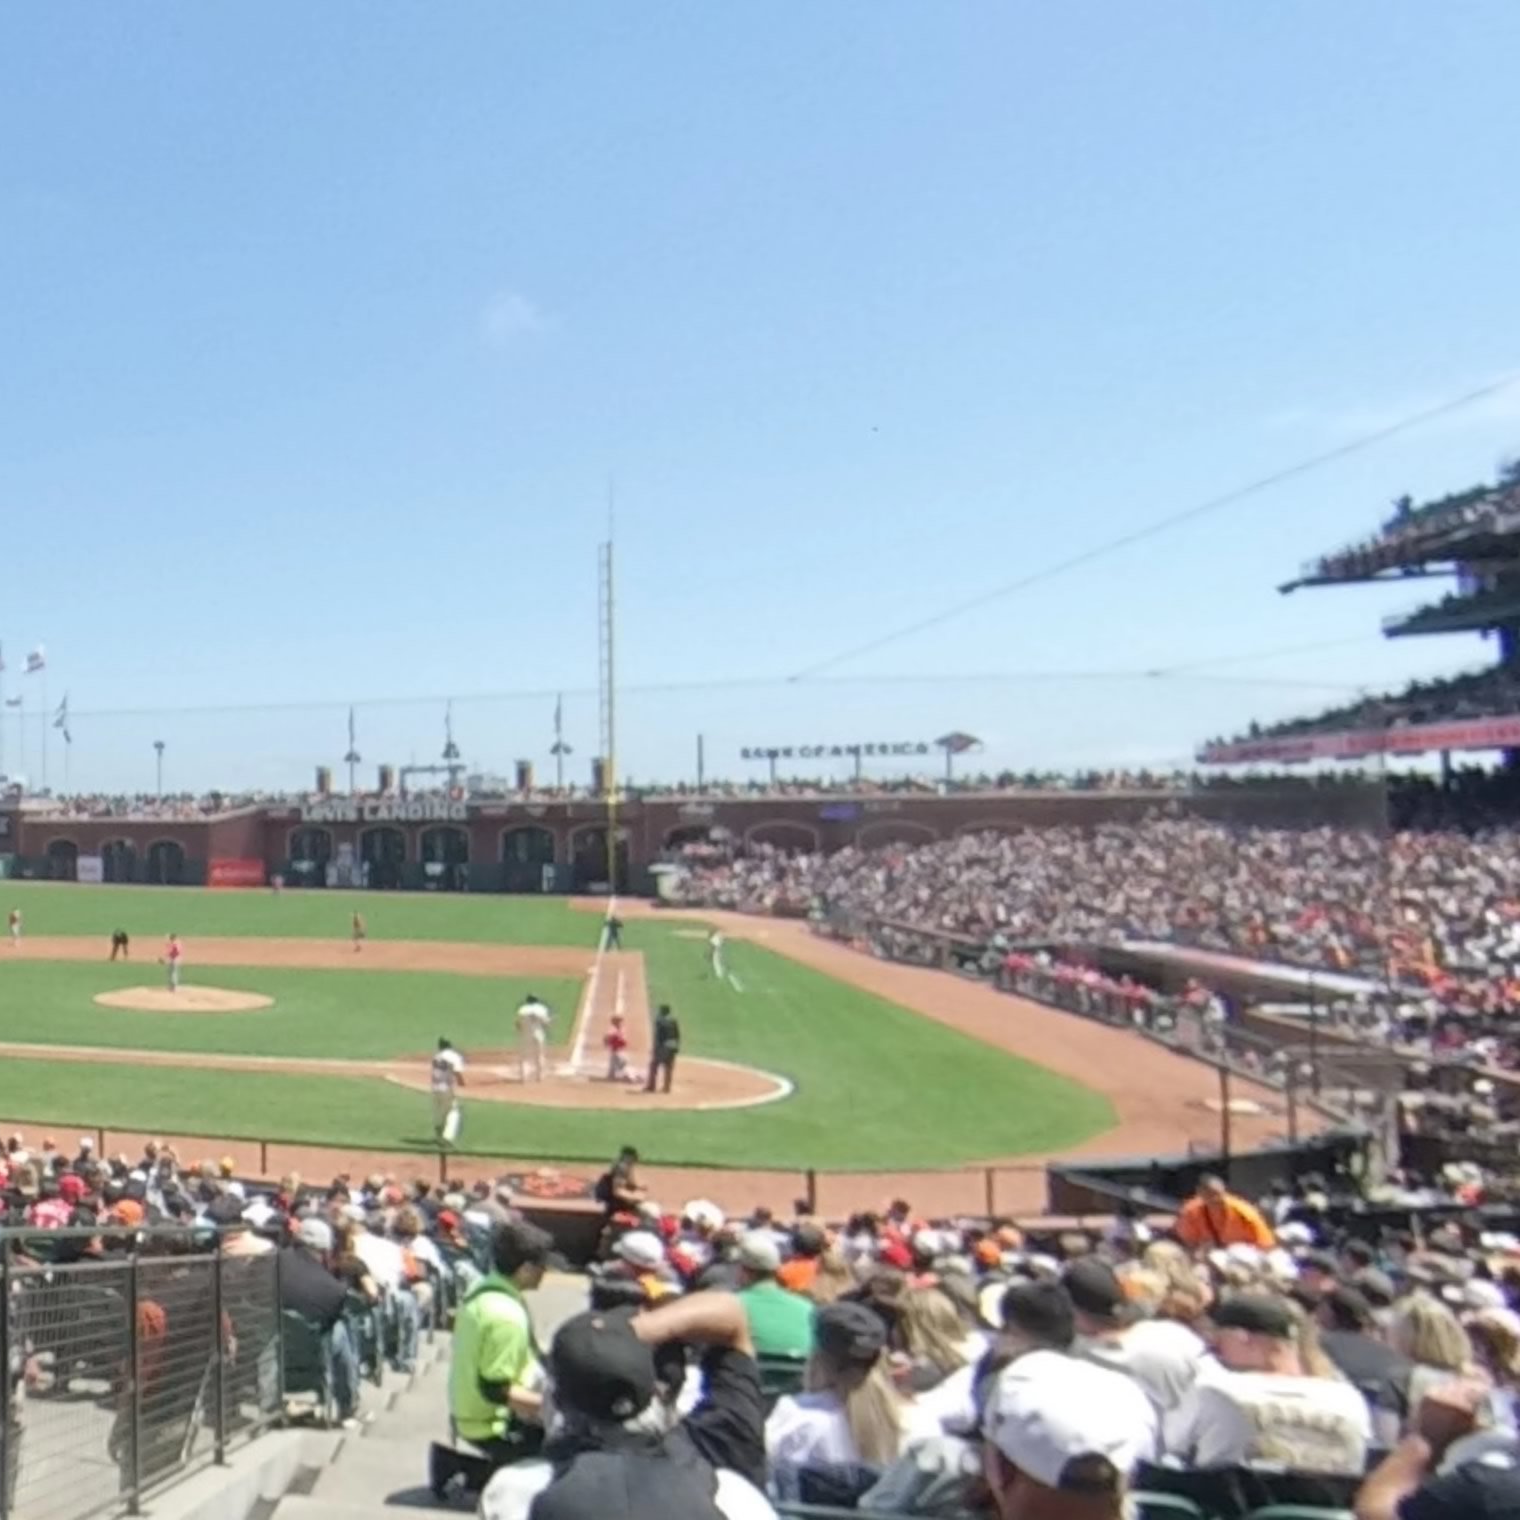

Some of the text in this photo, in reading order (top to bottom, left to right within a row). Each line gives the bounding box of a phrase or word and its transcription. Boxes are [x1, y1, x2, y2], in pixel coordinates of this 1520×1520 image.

[741, 742, 929, 759] BANK OF AMERICA
[364, 801, 467, 821] LANDING
